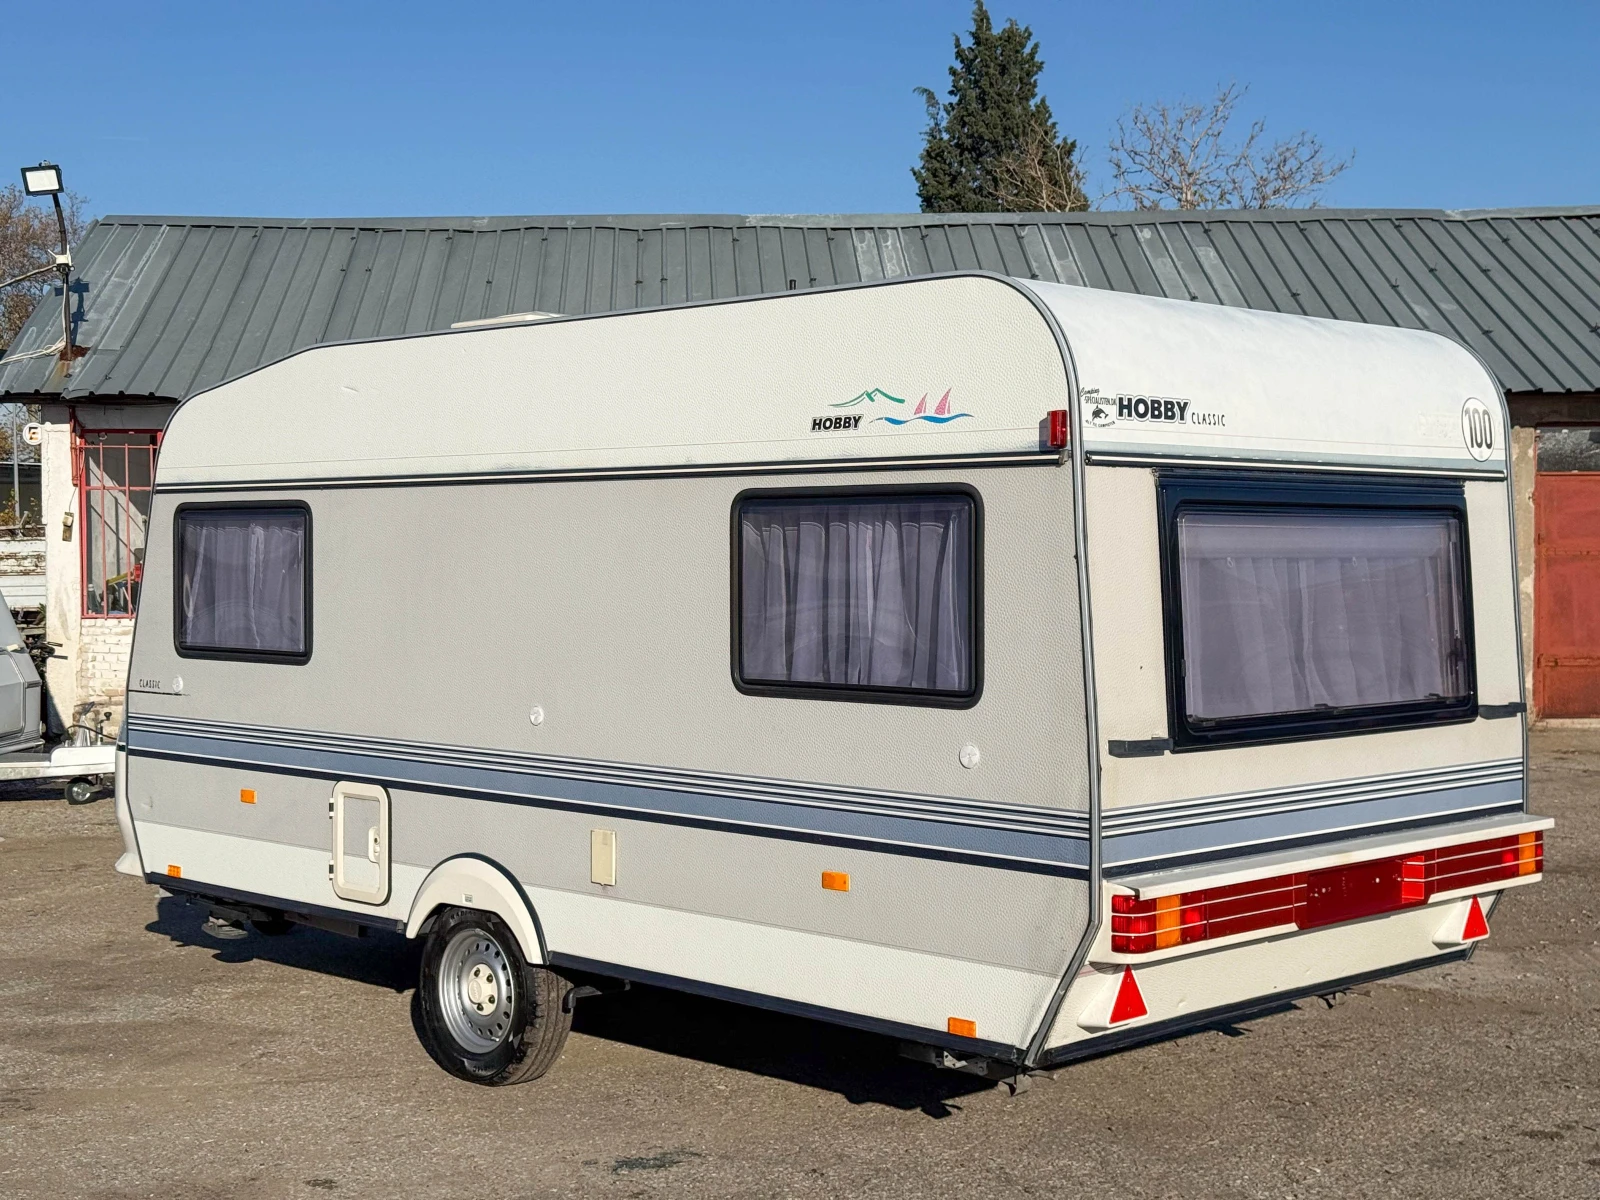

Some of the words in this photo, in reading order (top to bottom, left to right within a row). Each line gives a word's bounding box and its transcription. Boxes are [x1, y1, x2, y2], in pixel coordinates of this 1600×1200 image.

[811, 415, 863, 431] HOBBY
[1117, 395, 1190, 423] HOBBY
[1191, 412, 1226, 427] CLASSIC
[1464, 407, 1493, 449] 100
[139, 678, 161, 689] CLASSIC
